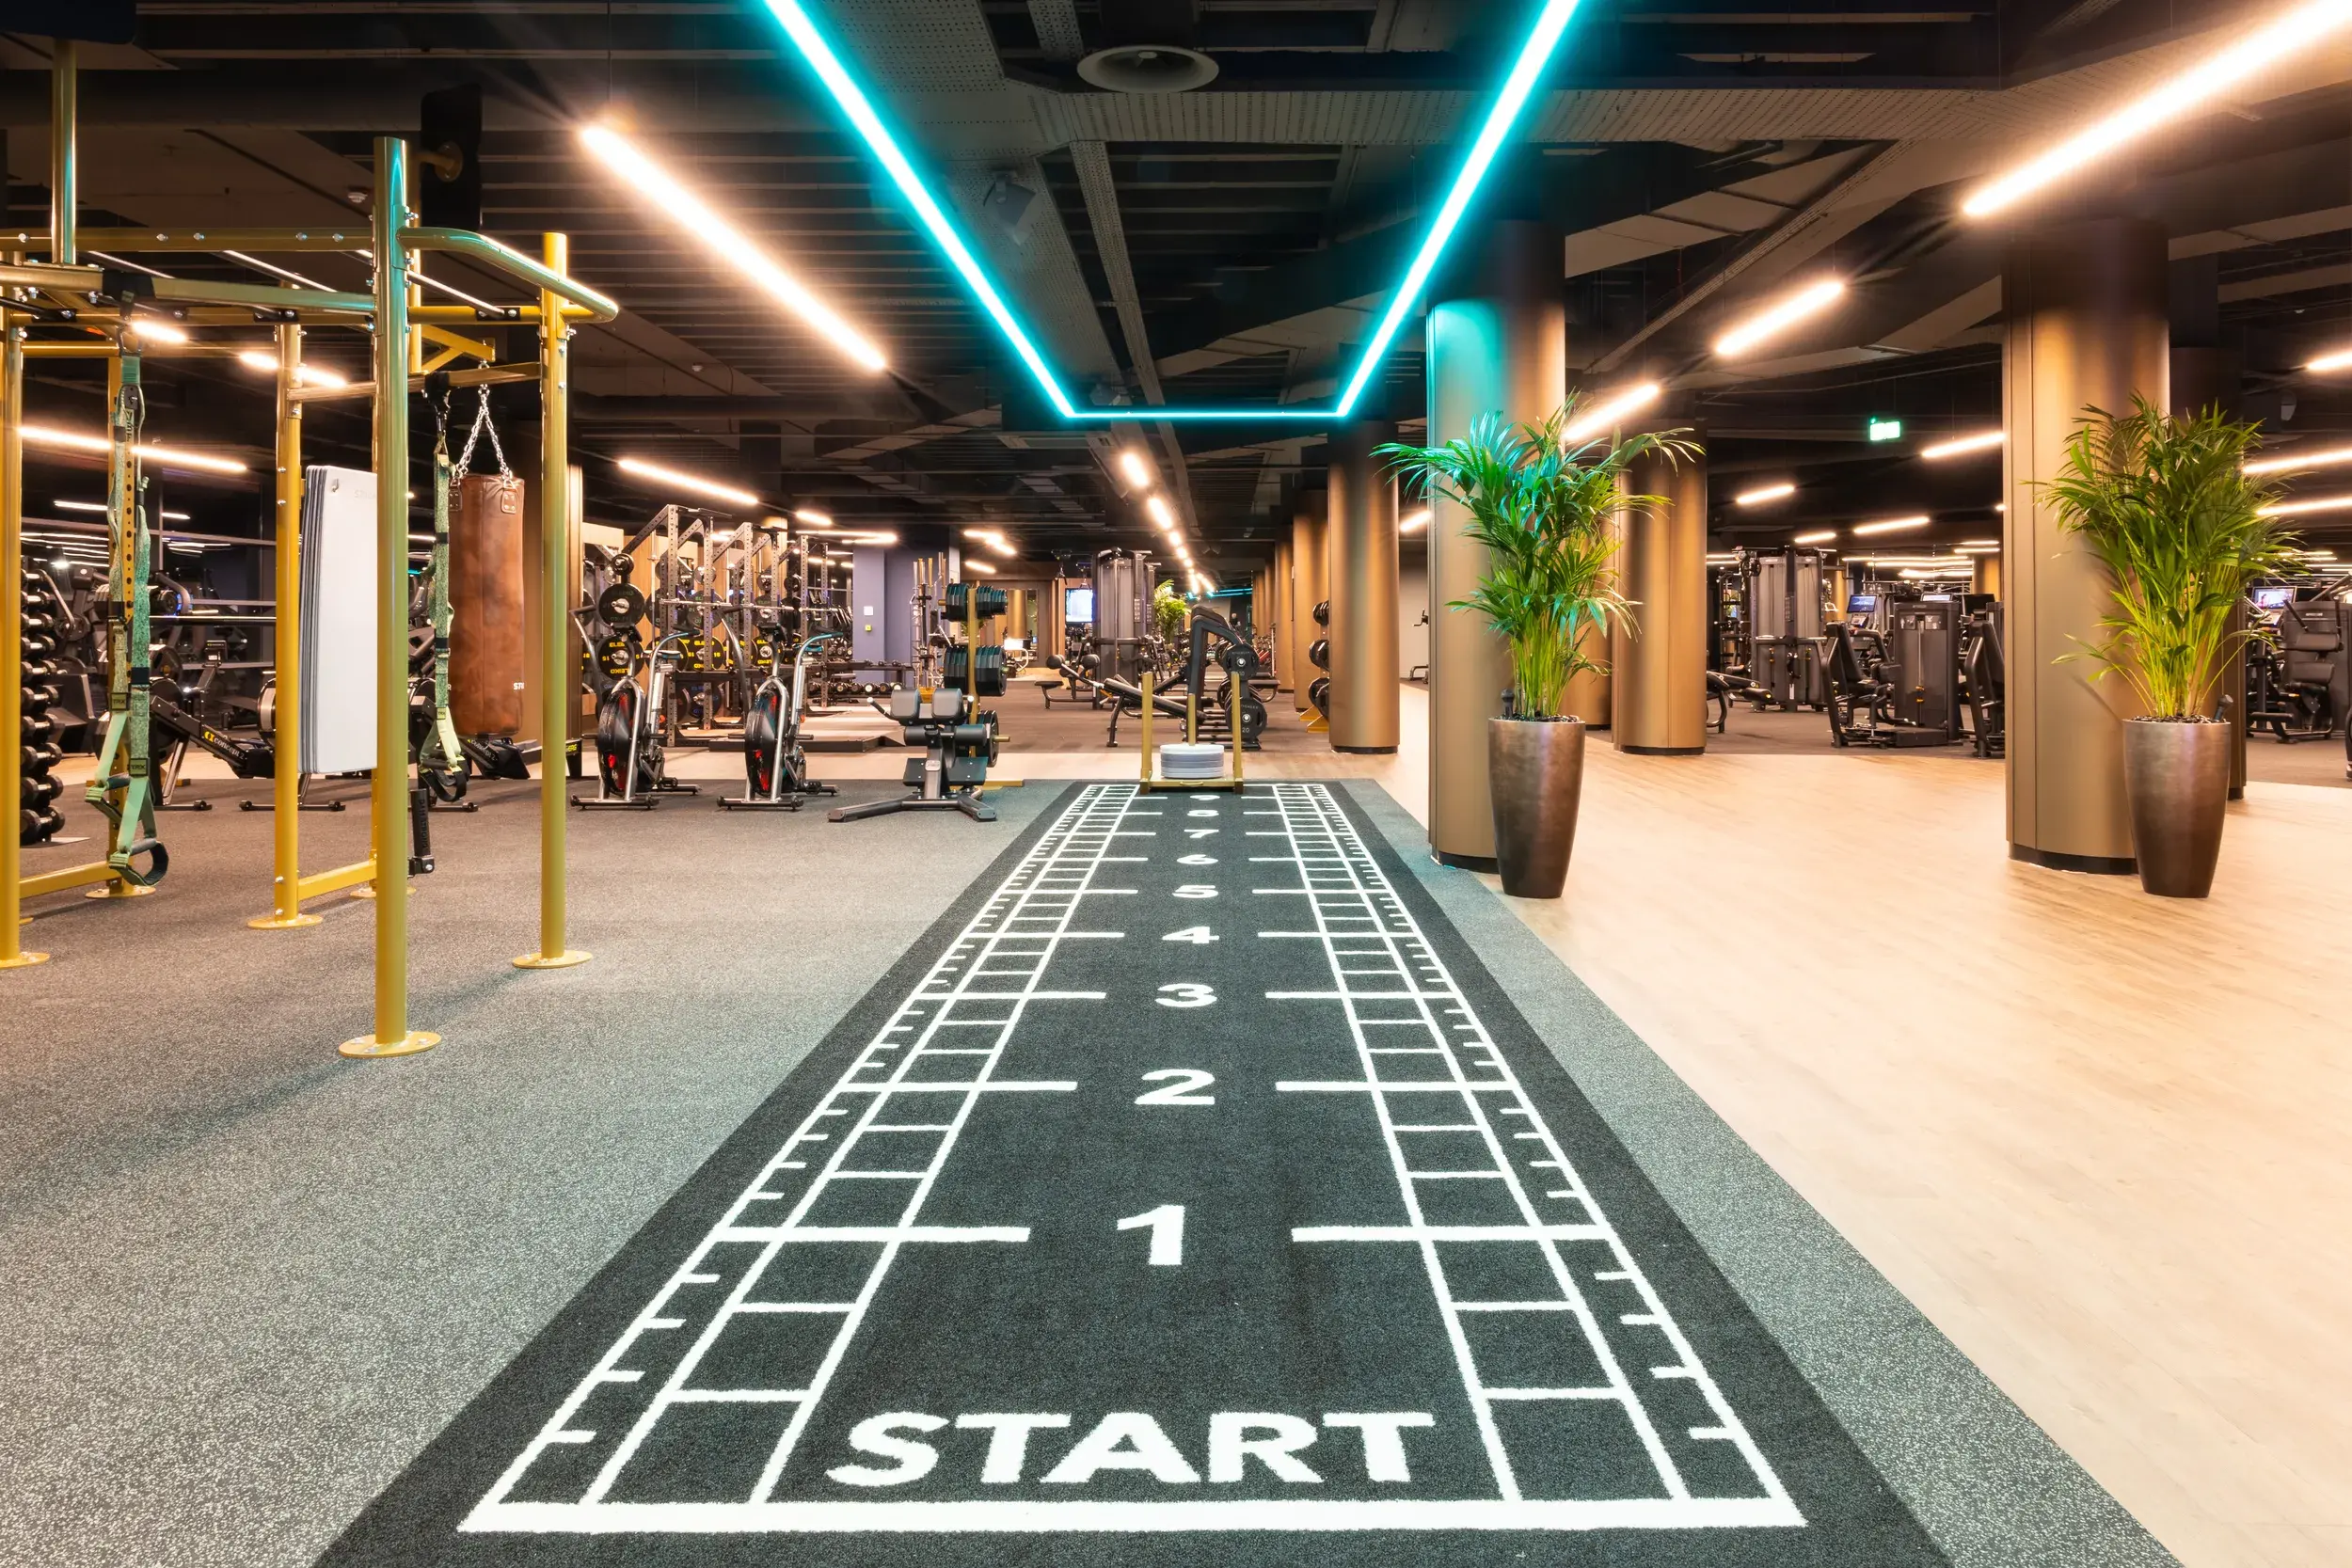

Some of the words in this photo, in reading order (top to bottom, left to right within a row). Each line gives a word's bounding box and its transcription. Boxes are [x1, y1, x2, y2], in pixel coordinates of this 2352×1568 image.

[1186, 809, 1219, 817] 8
[1184, 828, 1220, 839] 7
[1176, 853, 1219, 866] 6
[1171, 883, 1219, 899] 5
[1161, 925, 1220, 945] 4
[1154, 982, 1218, 1008] 3
[1134, 1068, 1216, 1106] 2
[1117, 1204, 1185, 1266] 1
[825, 1410, 1438, 1488] START
